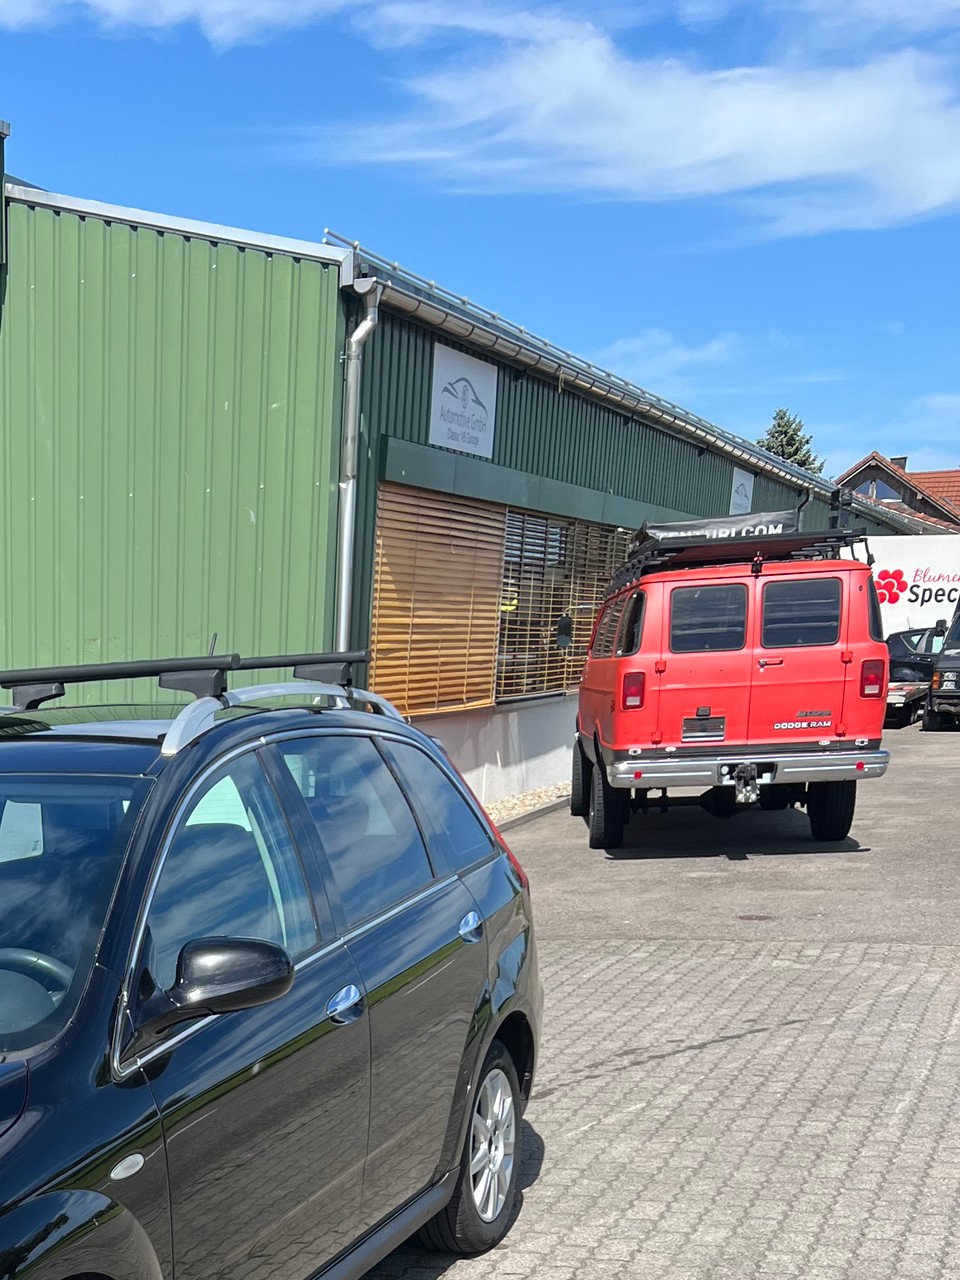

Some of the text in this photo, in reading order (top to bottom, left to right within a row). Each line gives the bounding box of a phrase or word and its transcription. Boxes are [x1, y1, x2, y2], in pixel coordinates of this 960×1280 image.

[913, 567, 960, 583] Blume
[774, 720, 832, 730] DODGE RAM
